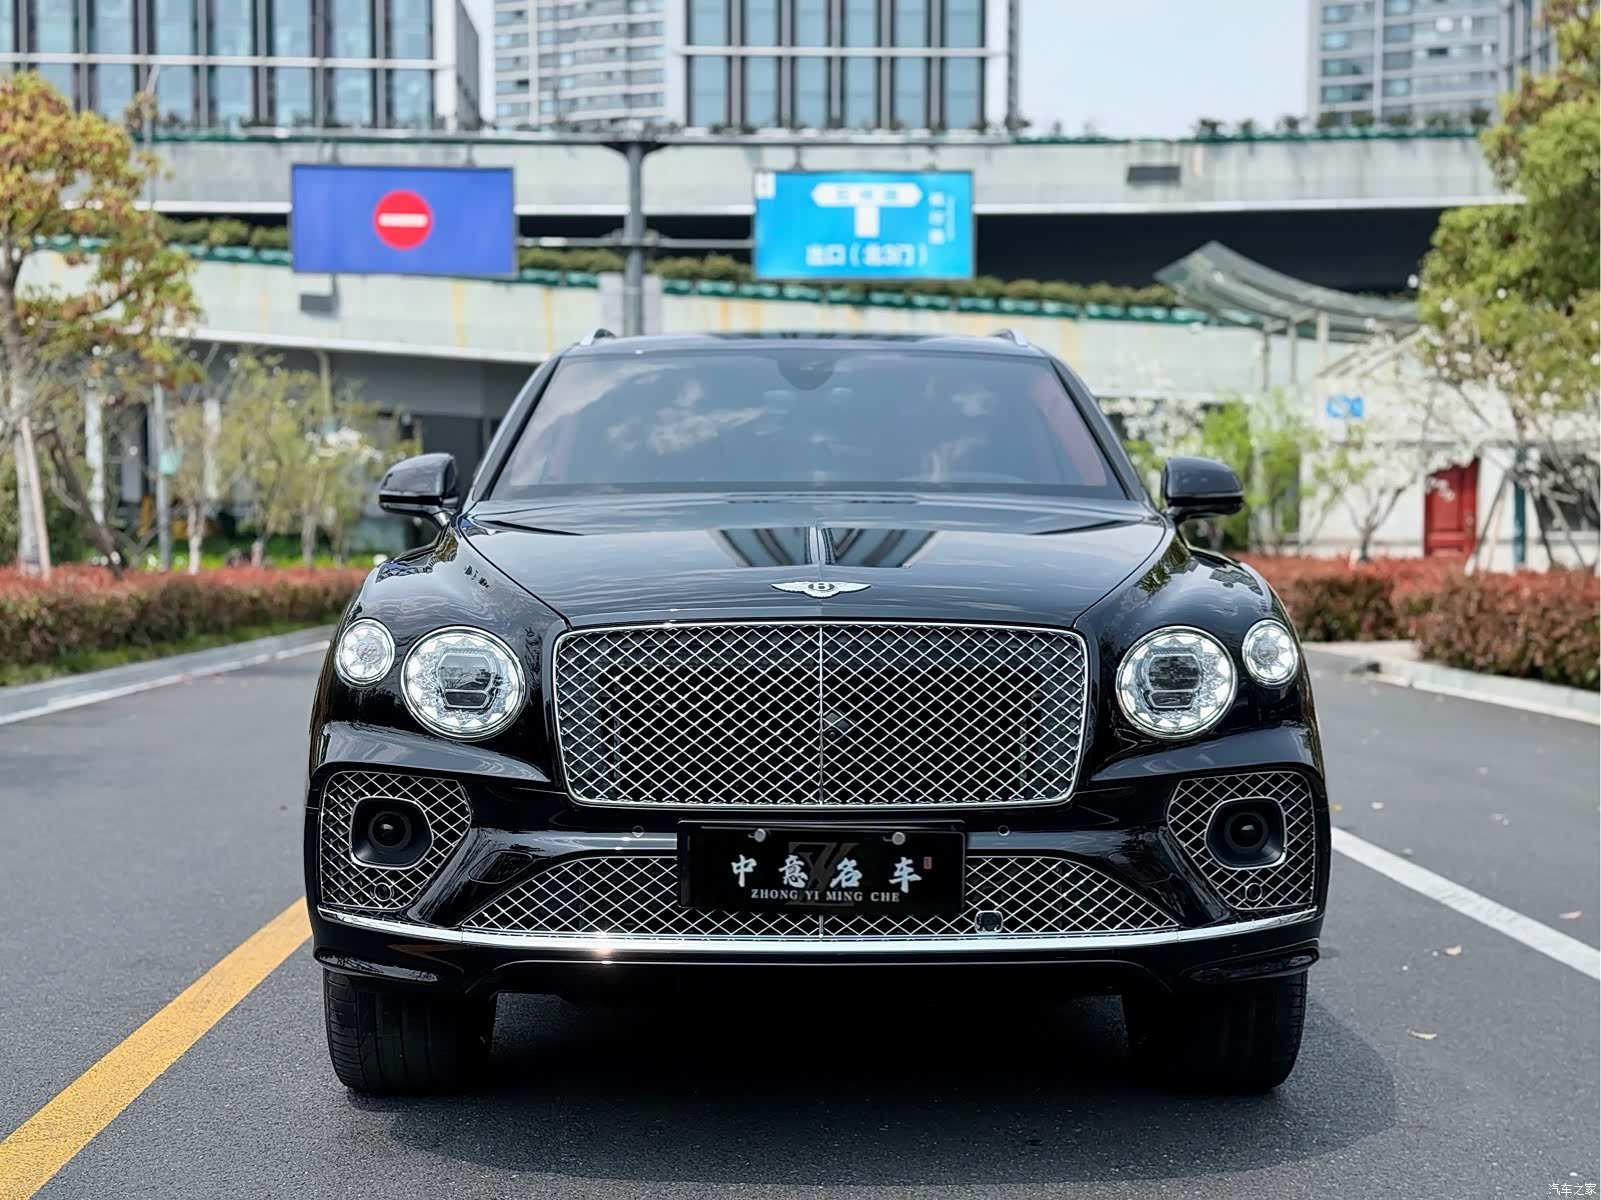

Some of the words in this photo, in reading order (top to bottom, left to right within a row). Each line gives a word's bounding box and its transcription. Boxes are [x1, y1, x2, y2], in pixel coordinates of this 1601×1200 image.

[730, 854, 922, 893] 中意名车
[751, 889, 798, 900] ZHONG
[805, 890, 819, 900] YI
[826, 891, 863, 901] MING
[870, 891, 900, 902] CHE
